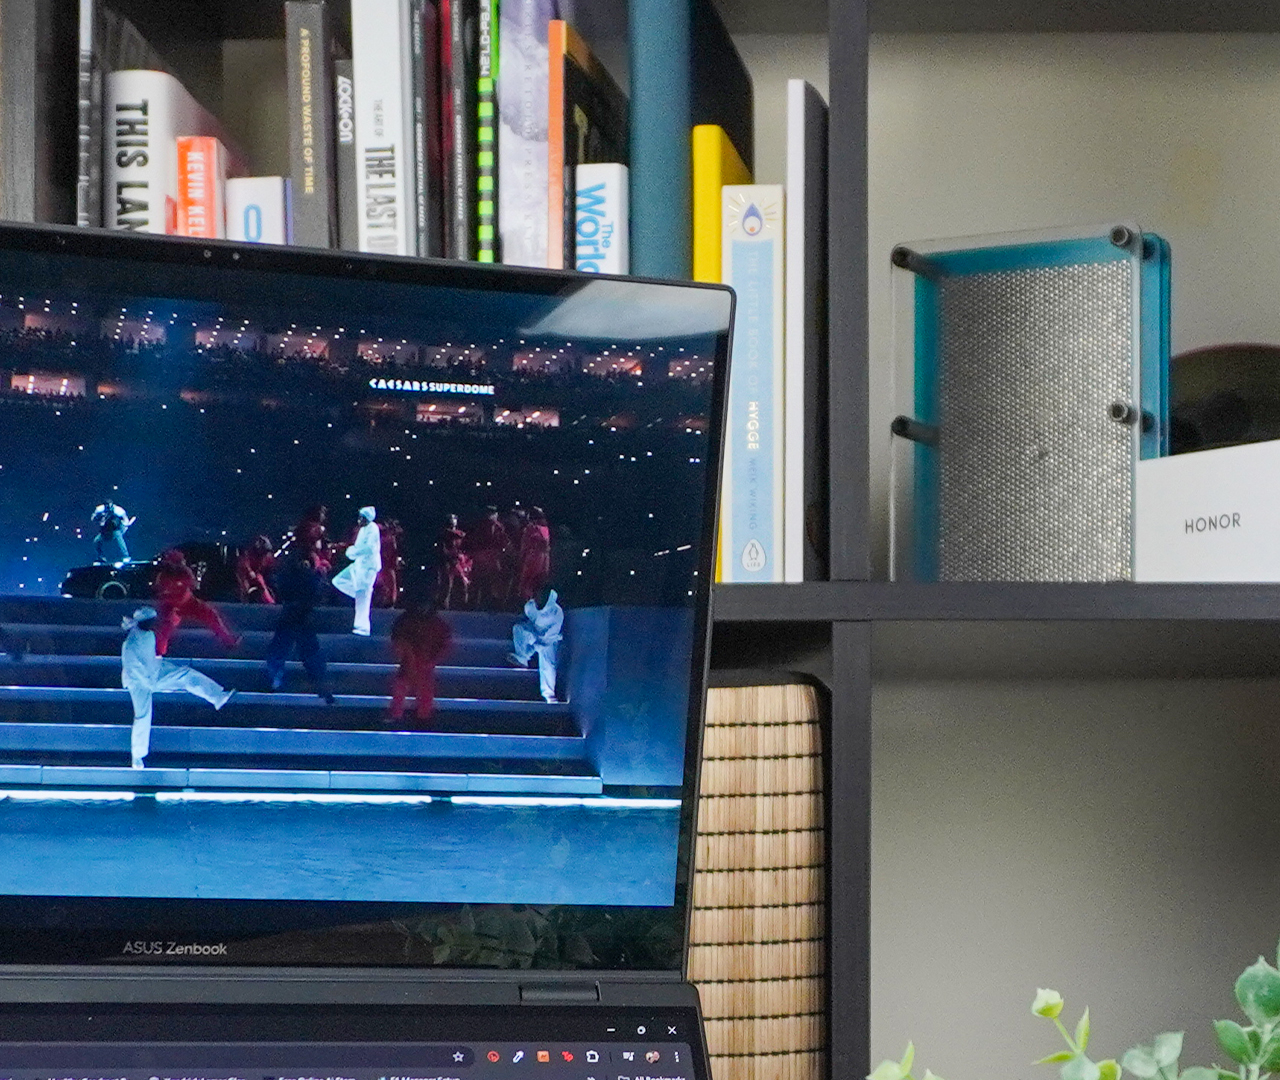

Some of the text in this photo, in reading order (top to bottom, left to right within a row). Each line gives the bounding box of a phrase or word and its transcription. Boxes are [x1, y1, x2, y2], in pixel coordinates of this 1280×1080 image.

[299, 39, 311, 103] PROFOUND
[116, 99, 149, 168] THIS
[302, 105, 312, 145] WASTE
[186, 151, 204, 198] KEVIN
[303, 148, 313, 163] OF
[304, 166, 314, 194] TIME
[365, 144, 397, 231] THE LAST
[601, 221, 614, 248] The
[747, 400, 759, 451] HYGGE
[750, 489, 758, 531] WIKING
[1184, 512, 1242, 535] HONOR
[123, 941, 228, 956] ASUS Zenbook
